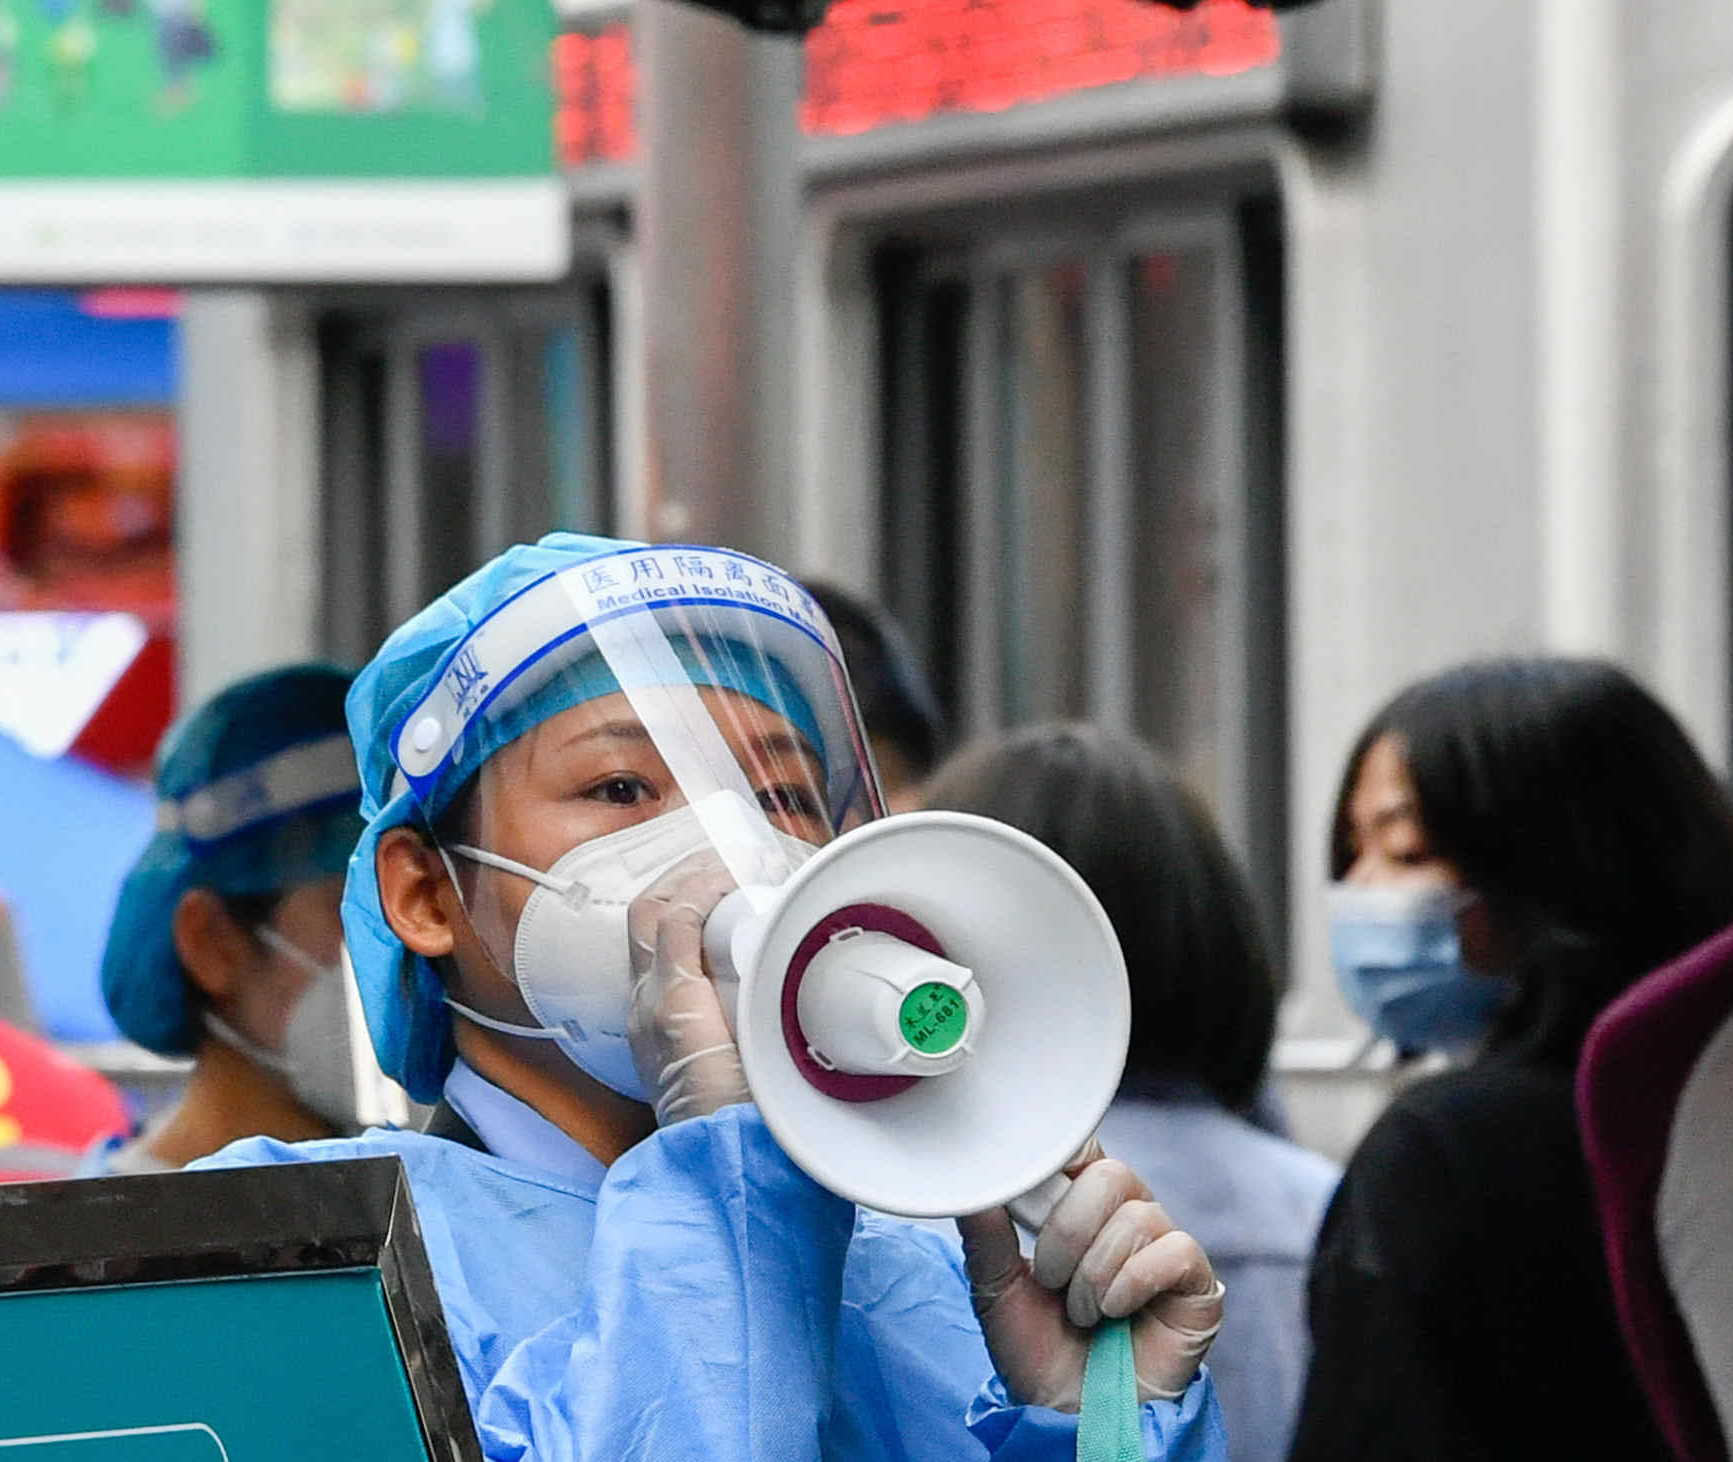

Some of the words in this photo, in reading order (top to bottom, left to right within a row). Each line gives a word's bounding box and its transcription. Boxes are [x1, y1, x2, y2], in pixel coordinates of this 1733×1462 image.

[597, 583, 686, 611] Medical
[693, 584, 784, 613] Isolation
[913, 999, 960, 1046] ML-681
